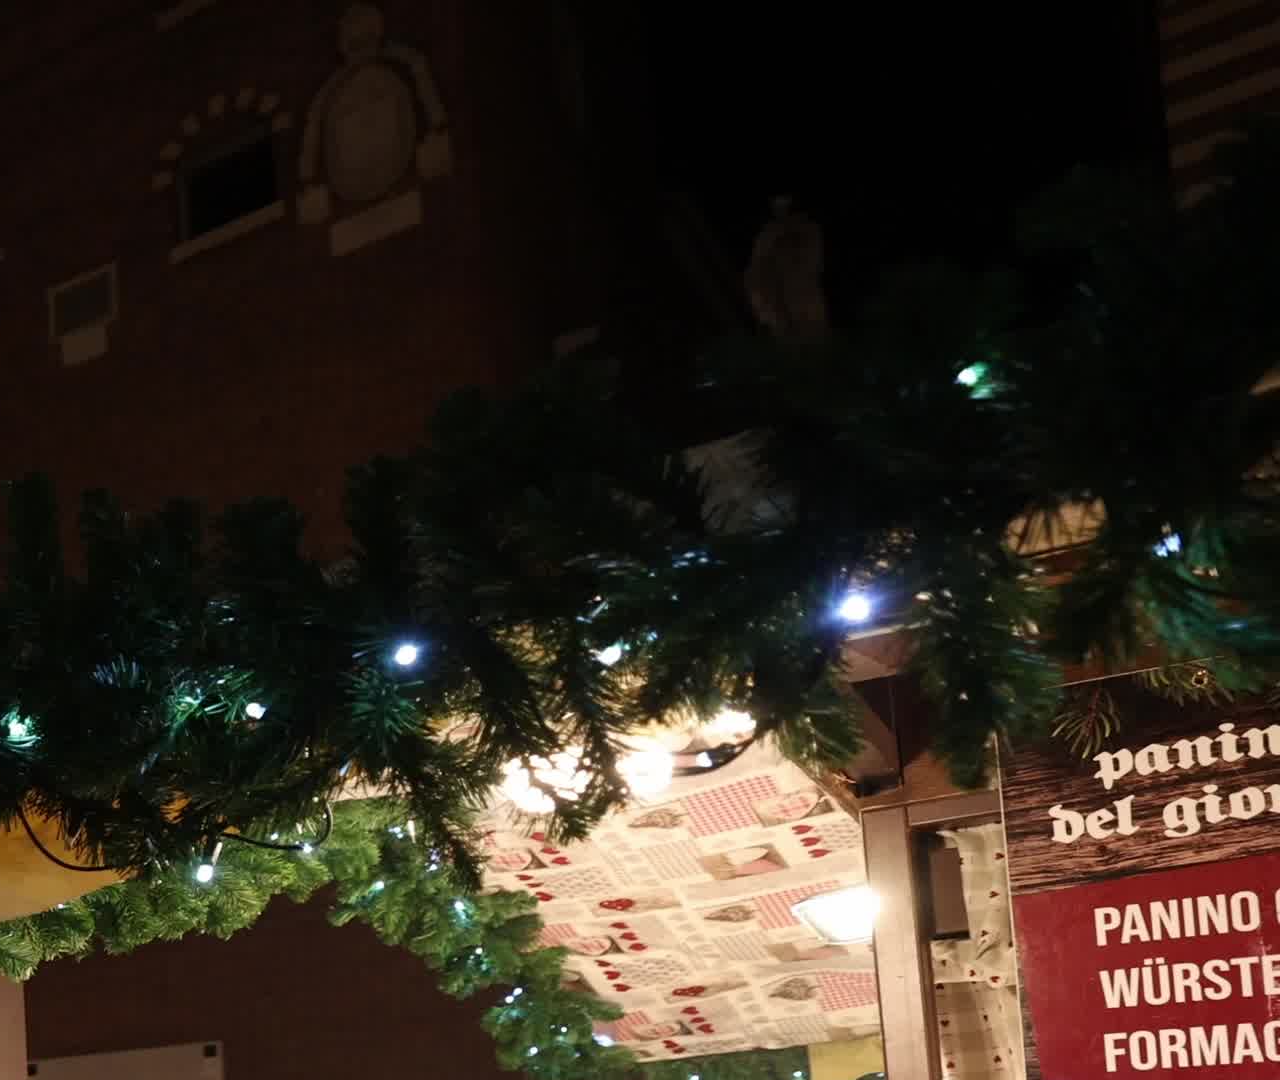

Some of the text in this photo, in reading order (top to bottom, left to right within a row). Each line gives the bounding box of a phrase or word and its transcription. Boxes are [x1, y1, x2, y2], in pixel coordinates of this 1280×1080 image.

[1048, 794, 1139, 844] del
[1093, 890, 1261, 947] PANINO
[1098, 956, 1280, 1009] WÜRSTE
